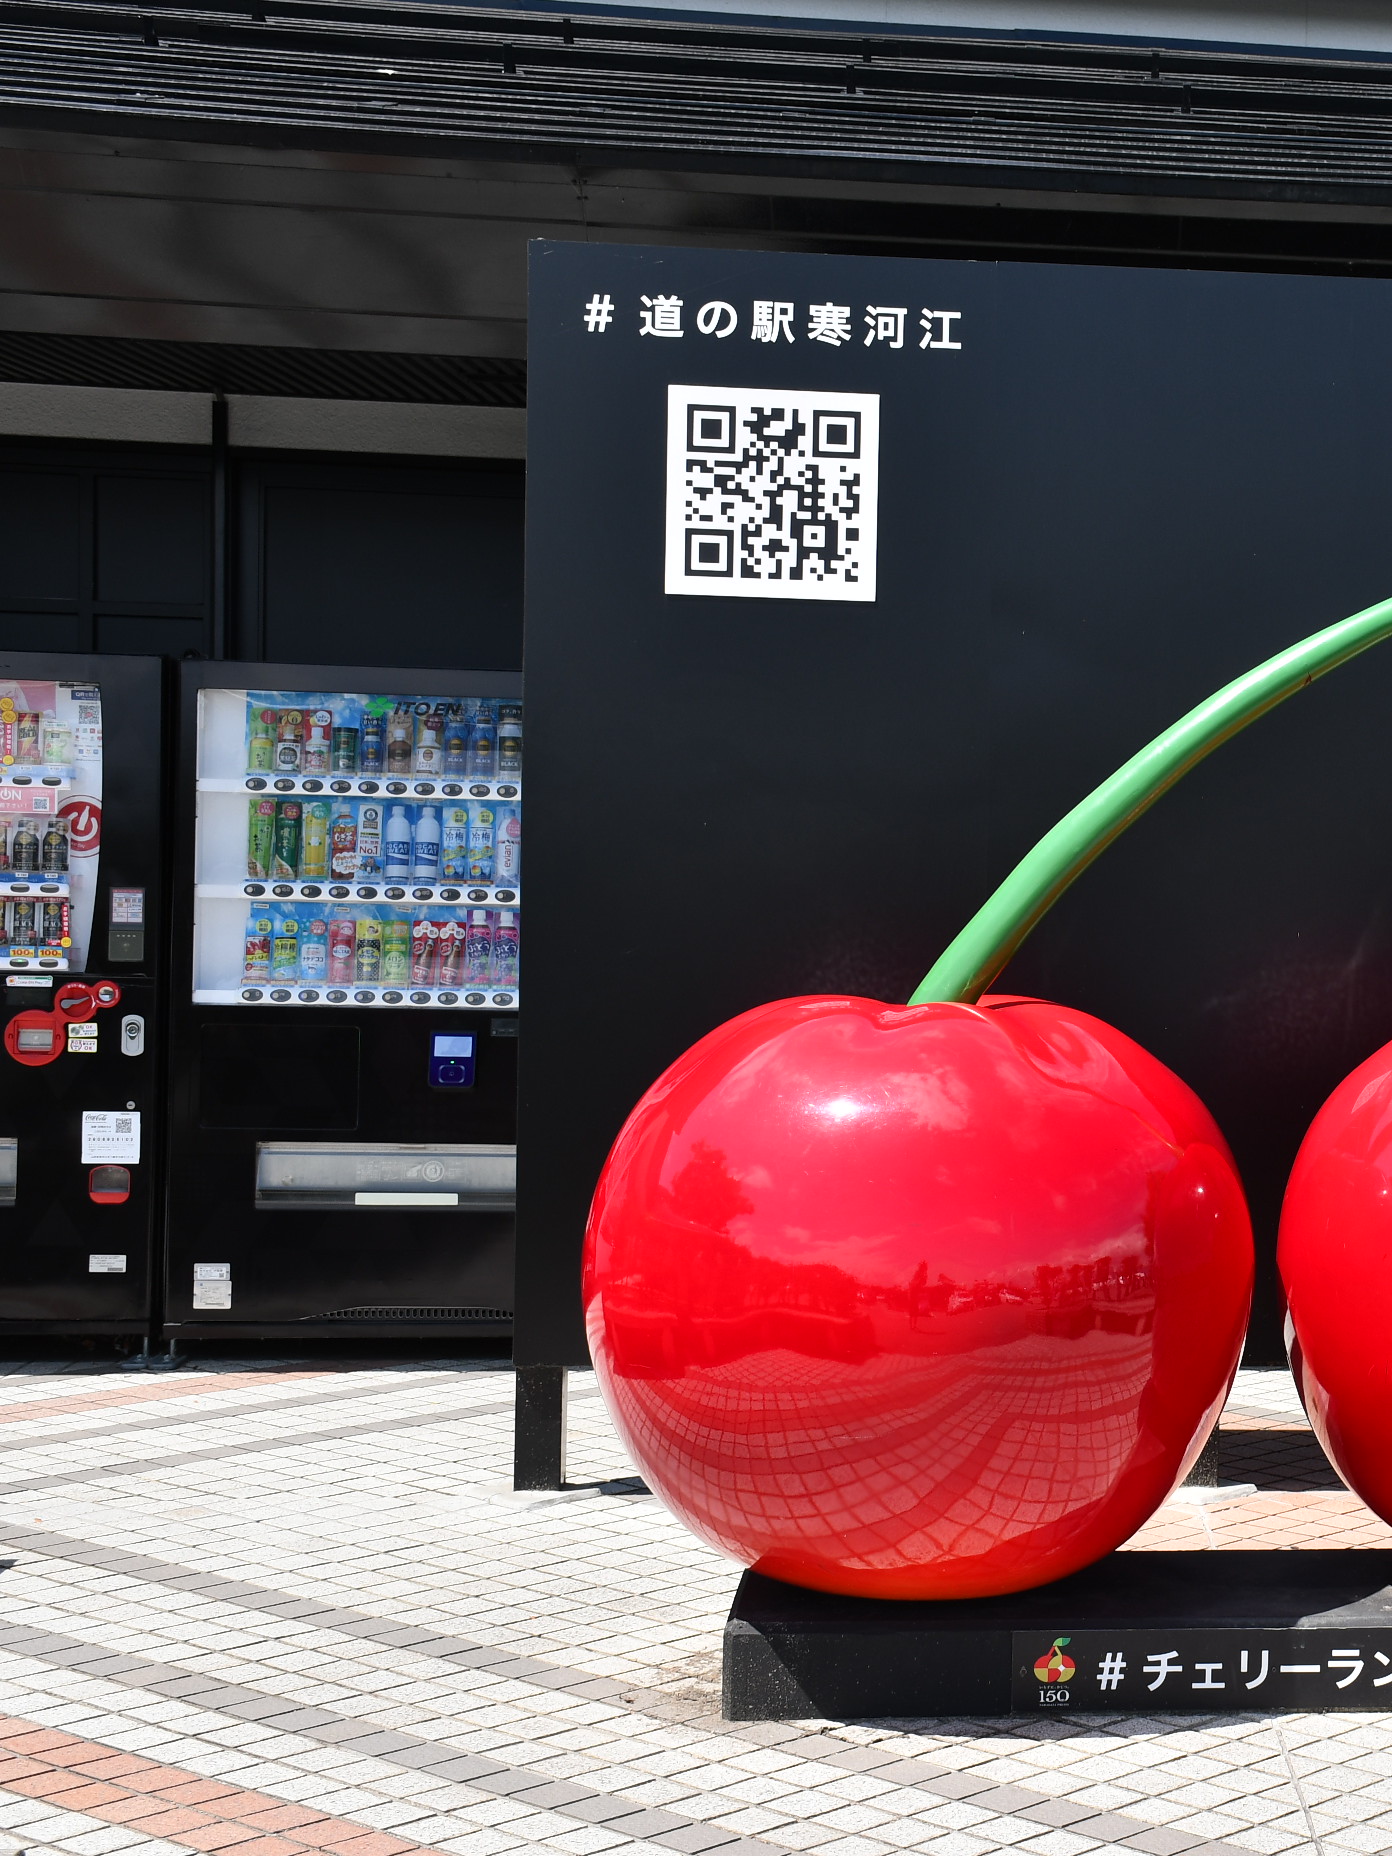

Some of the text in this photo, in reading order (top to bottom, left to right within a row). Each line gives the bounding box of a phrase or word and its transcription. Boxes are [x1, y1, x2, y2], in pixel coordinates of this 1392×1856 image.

[360, 846, 378, 855] No.1
[504, 845, 512, 868] evian
[1039, 1689, 1070, 1703] 150
